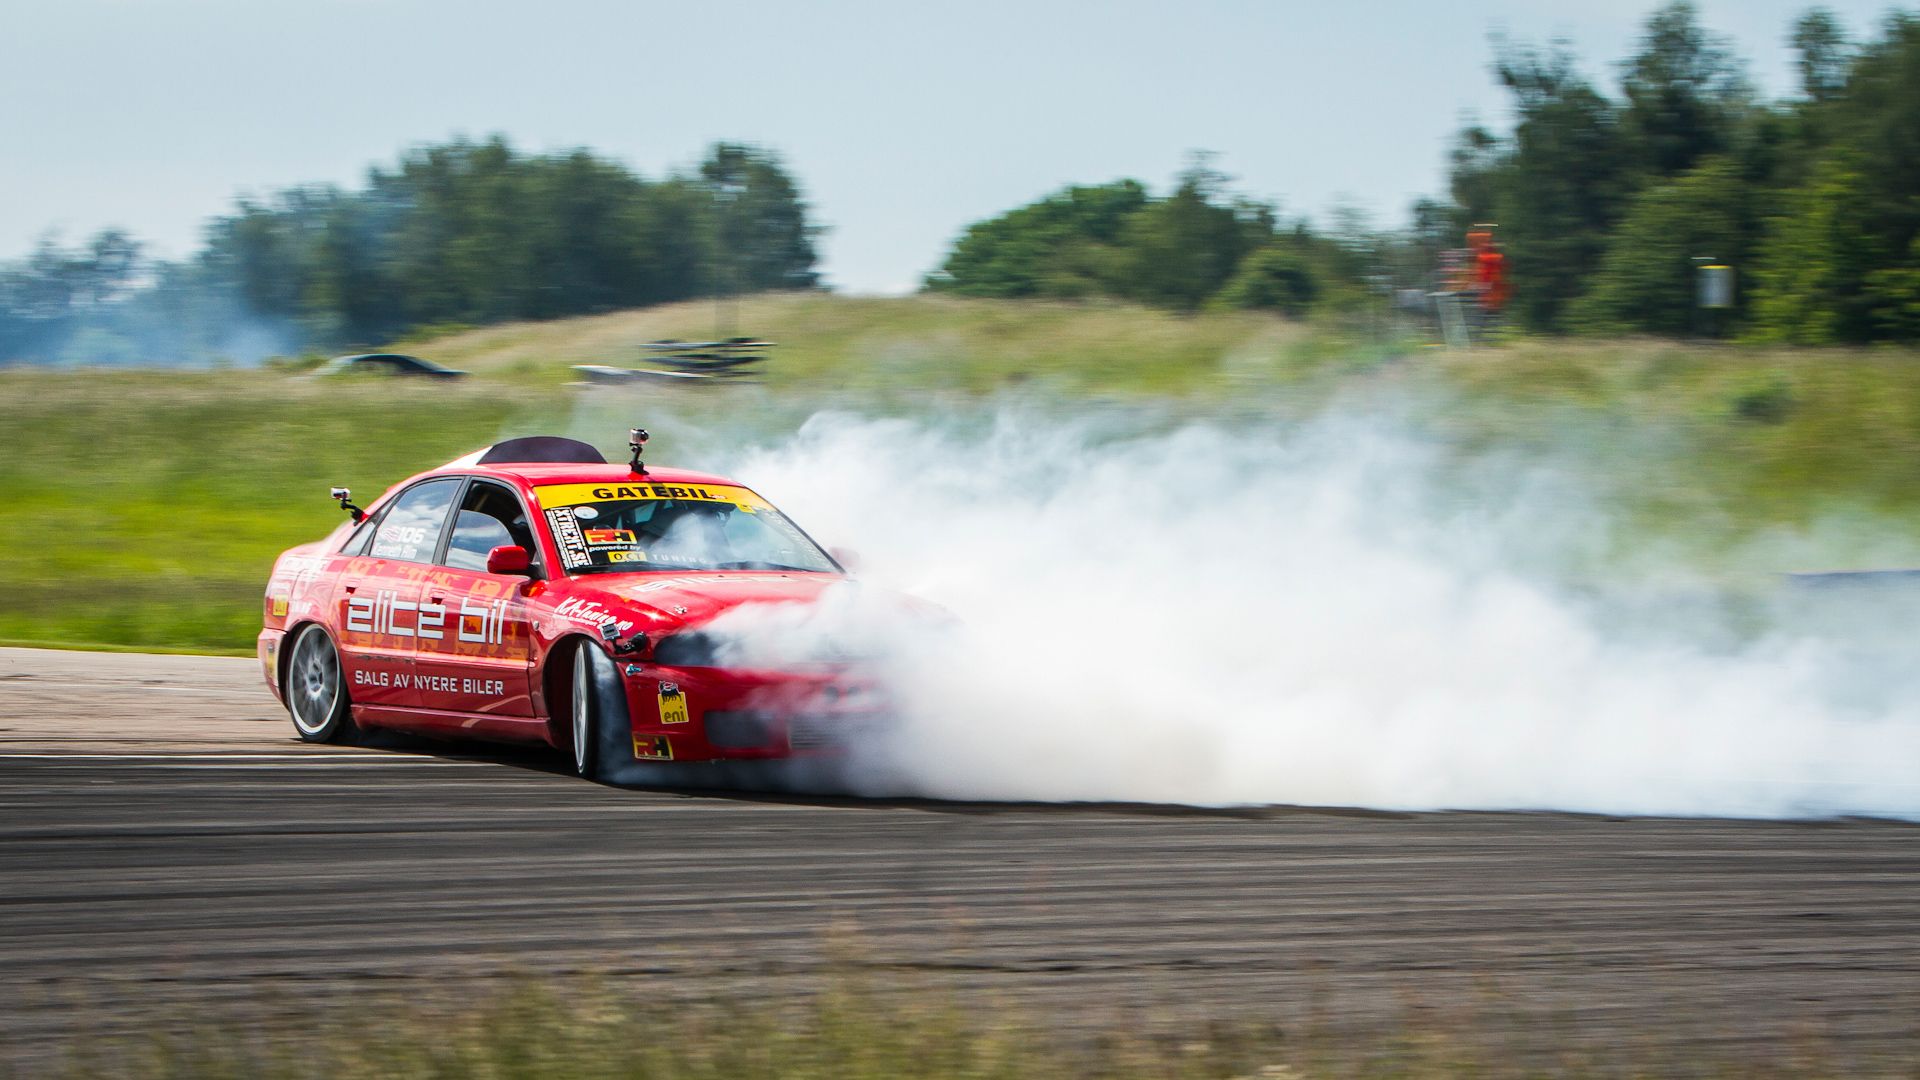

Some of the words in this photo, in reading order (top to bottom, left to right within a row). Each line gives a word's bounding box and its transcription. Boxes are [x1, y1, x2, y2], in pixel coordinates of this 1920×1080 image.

[592, 486, 714, 499] GATEBIL
[401, 527, 427, 544] 106
[588, 545, 628, 553] powered
[630, 544, 641, 552] by
[346, 590, 446, 640] elite
[458, 597, 508, 645] bil
[355, 670, 389, 687] SALG
[393, 673, 411, 689] AV
[414, 675, 458, 693] NYERE
[463, 678, 504, 696] BILER
[664, 705, 686, 722] eni
